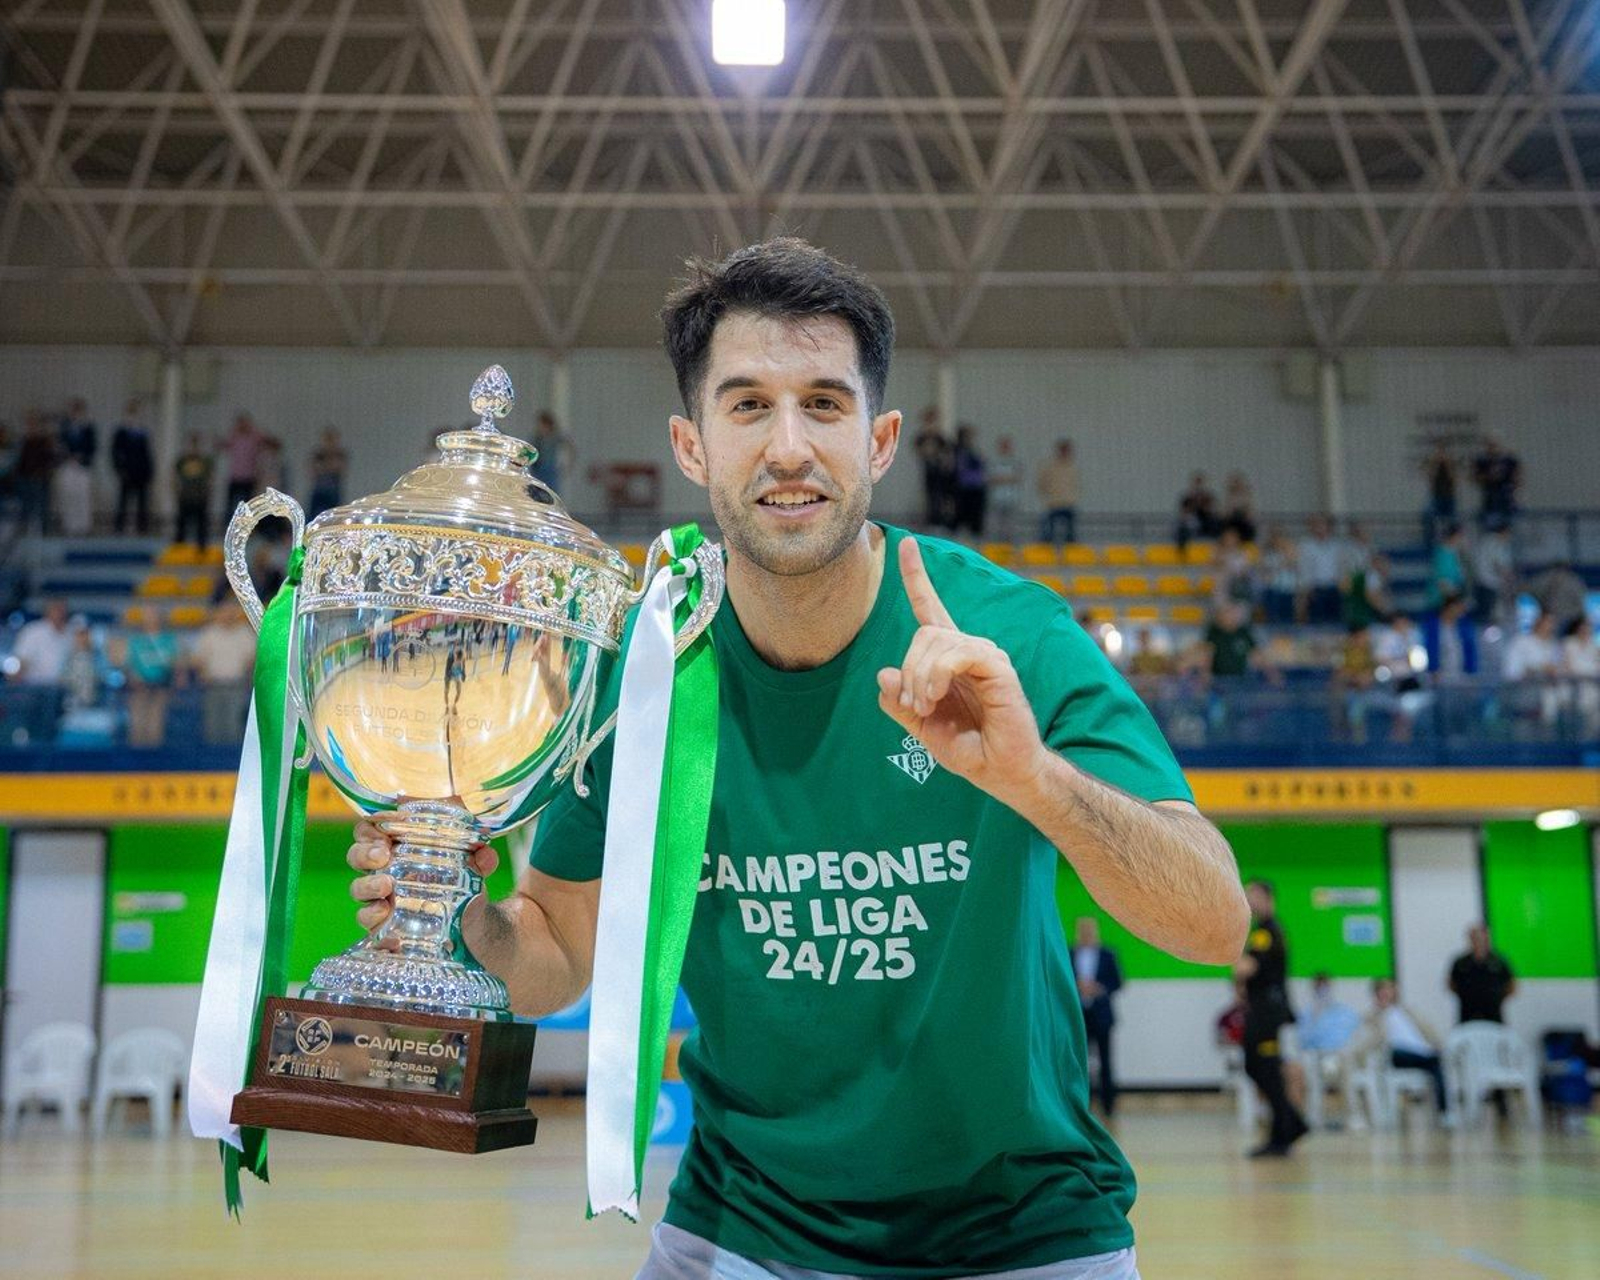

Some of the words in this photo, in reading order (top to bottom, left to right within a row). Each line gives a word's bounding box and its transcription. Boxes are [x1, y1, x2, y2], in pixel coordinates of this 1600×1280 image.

[335, 704, 408, 722] SEGUNDA
[697, 840, 971, 893] CAMPEONES
[738, 899, 797, 937] DE
[809, 895, 928, 936] LIGA
[763, 937, 916, 985] 24/25
[354, 1034, 460, 1059] CAMPEÓN
[369, 1058, 438, 1074] TEMPORADA
